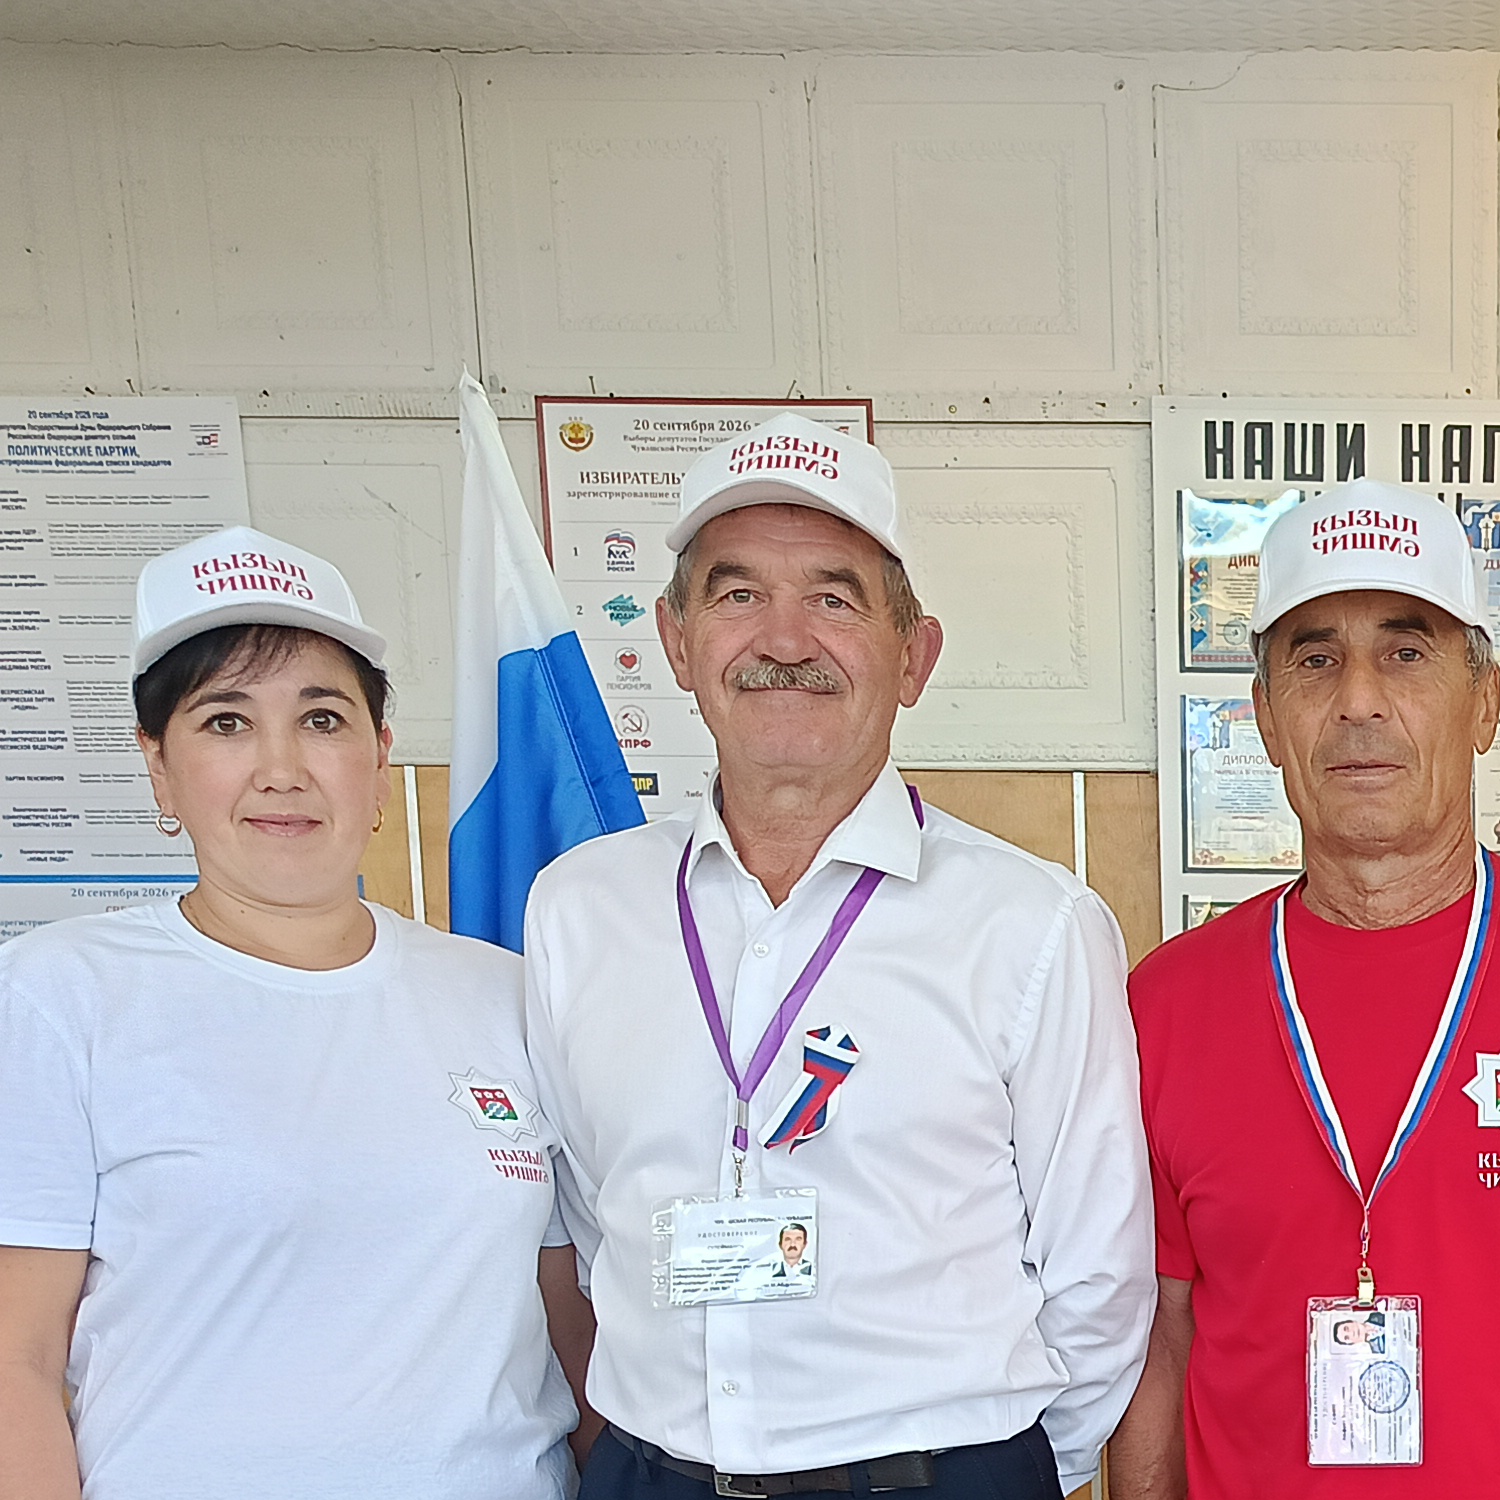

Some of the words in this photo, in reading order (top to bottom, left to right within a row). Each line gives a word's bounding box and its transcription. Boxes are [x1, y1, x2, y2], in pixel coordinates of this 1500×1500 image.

[633, 419, 649, 430] 20
[653, 419, 715, 433] сентября
[719, 420, 751, 431] 2026
[8, 445, 93, 457] ПОЛИТИЧЕСКИЕ
[729, 435, 840, 464] КЫЗЫЛ
[1204, 420, 1366, 481] НАШИ
[580, 471, 685, 485] ИЗБИРАТЕЛЬ
[1312, 509, 1418, 537] КЫЗЫЛ
[573, 547, 578, 556] 1
[192, 552, 308, 583] КЫЗЫЛ
[576, 605, 583, 615] 2
[71, 888, 84, 897] 20
[87, 888, 139, 899] сентября
[142, 888, 168, 897] 2026
